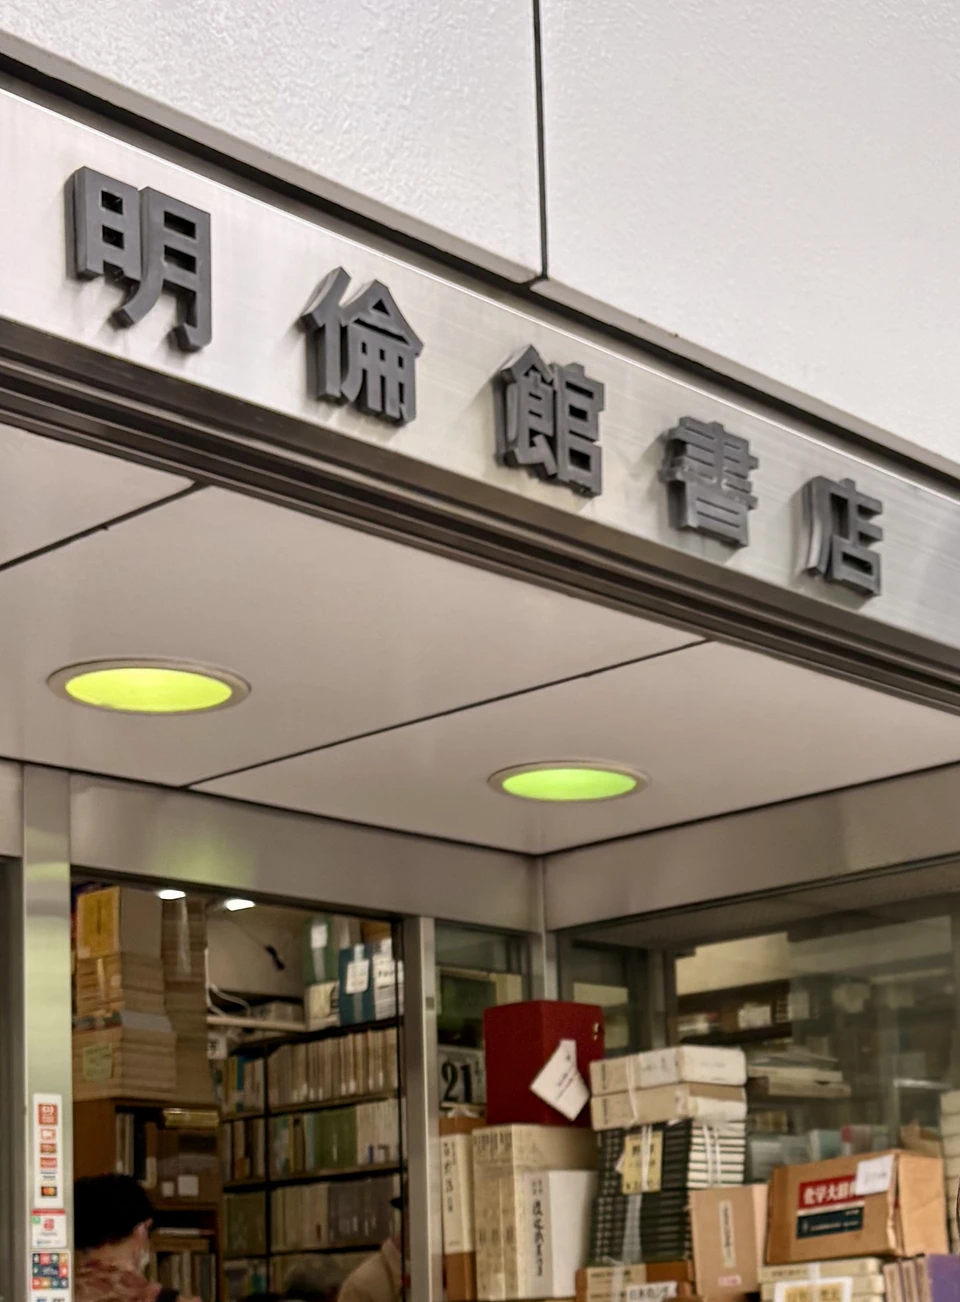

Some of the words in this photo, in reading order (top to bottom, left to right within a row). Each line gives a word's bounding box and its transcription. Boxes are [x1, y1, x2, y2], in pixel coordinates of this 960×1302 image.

[66, 165, 884, 598] 明倫館書店
[441, 1060, 473, 1104] 21
